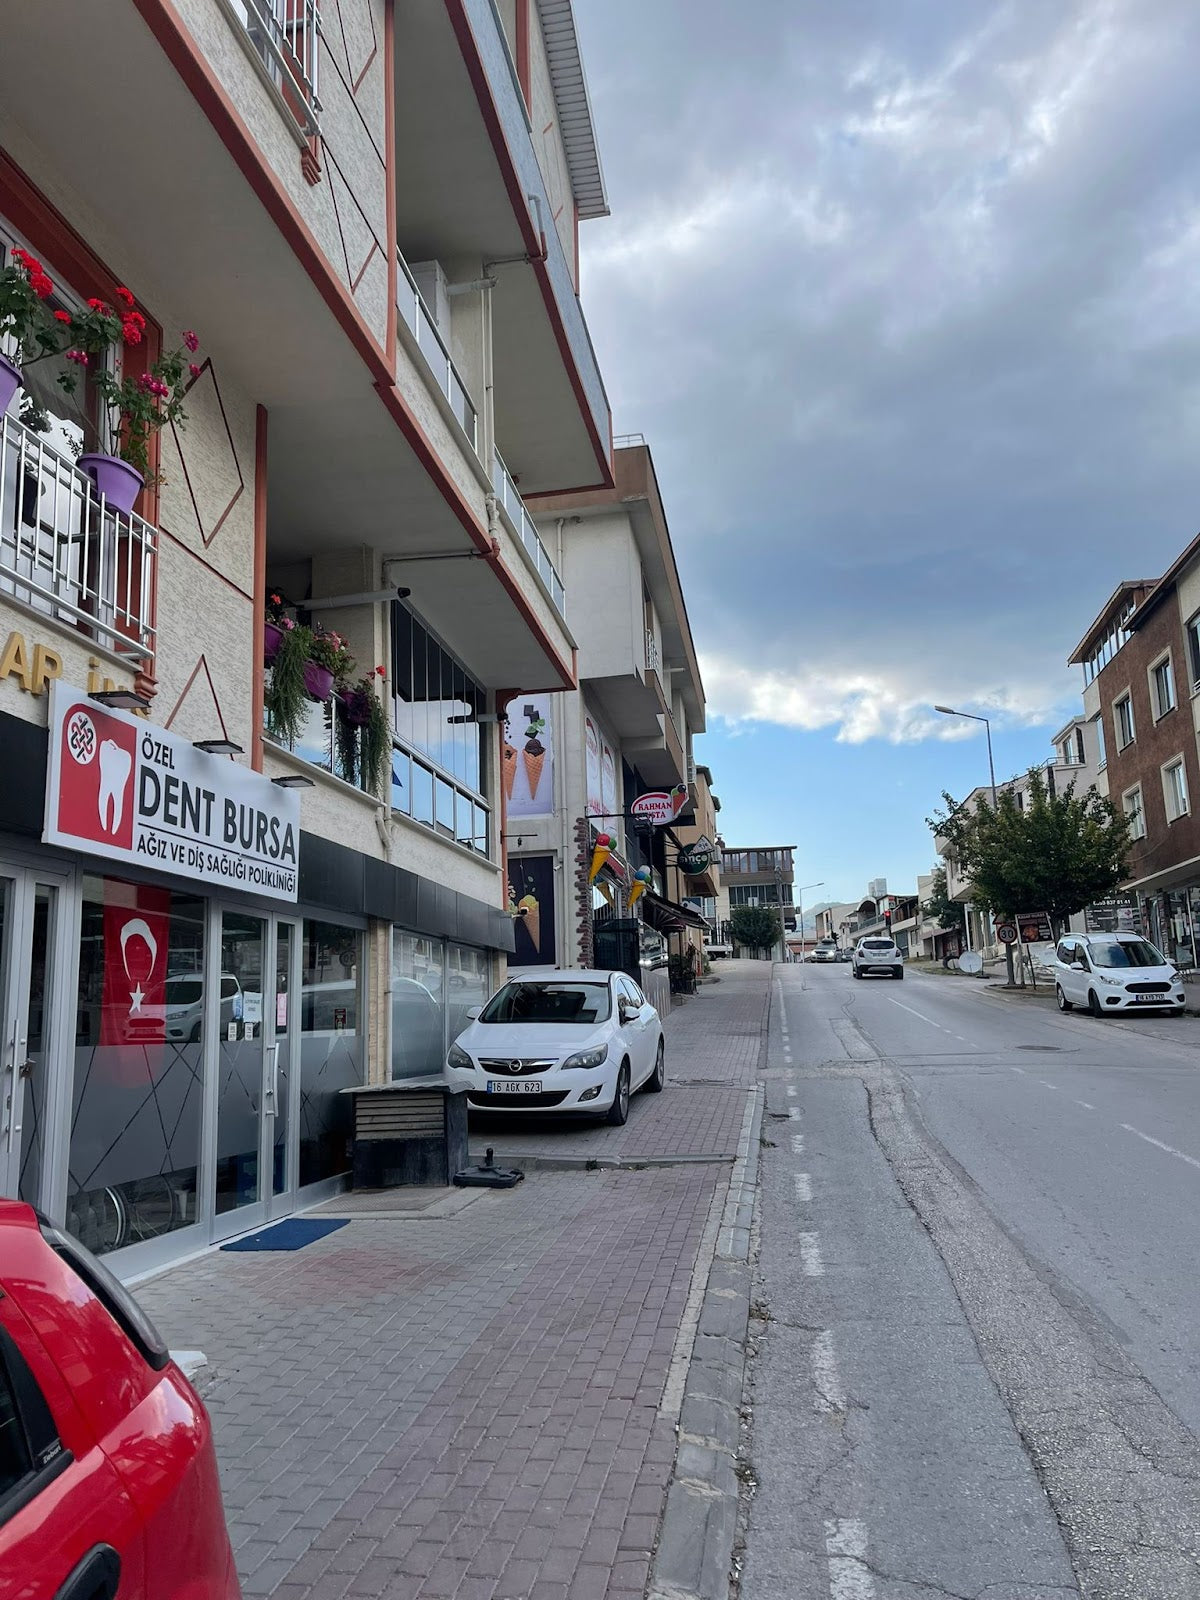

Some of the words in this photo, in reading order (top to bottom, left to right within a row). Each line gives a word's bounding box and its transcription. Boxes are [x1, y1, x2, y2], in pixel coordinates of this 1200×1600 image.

[141, 732, 175, 770] ÖZEL
[138, 764, 216, 837] DENT
[223, 797, 296, 864] BURSA
[638, 801, 672, 811] RAHMAN
[137, 831, 167, 859] AĞIZ
[170, 842, 185, 863] VE
[188, 846, 204, 873] DİŞ
[207, 854, 246, 882] SAĞLIĞI
[248, 865, 296, 893] POLİKLİNİĞİ
[1001, 930, 1014, 939] 30
[493, 1083, 501, 1092] 16
[506, 1083, 520, 1092] AGK
[524, 1083, 540, 1092] 623
